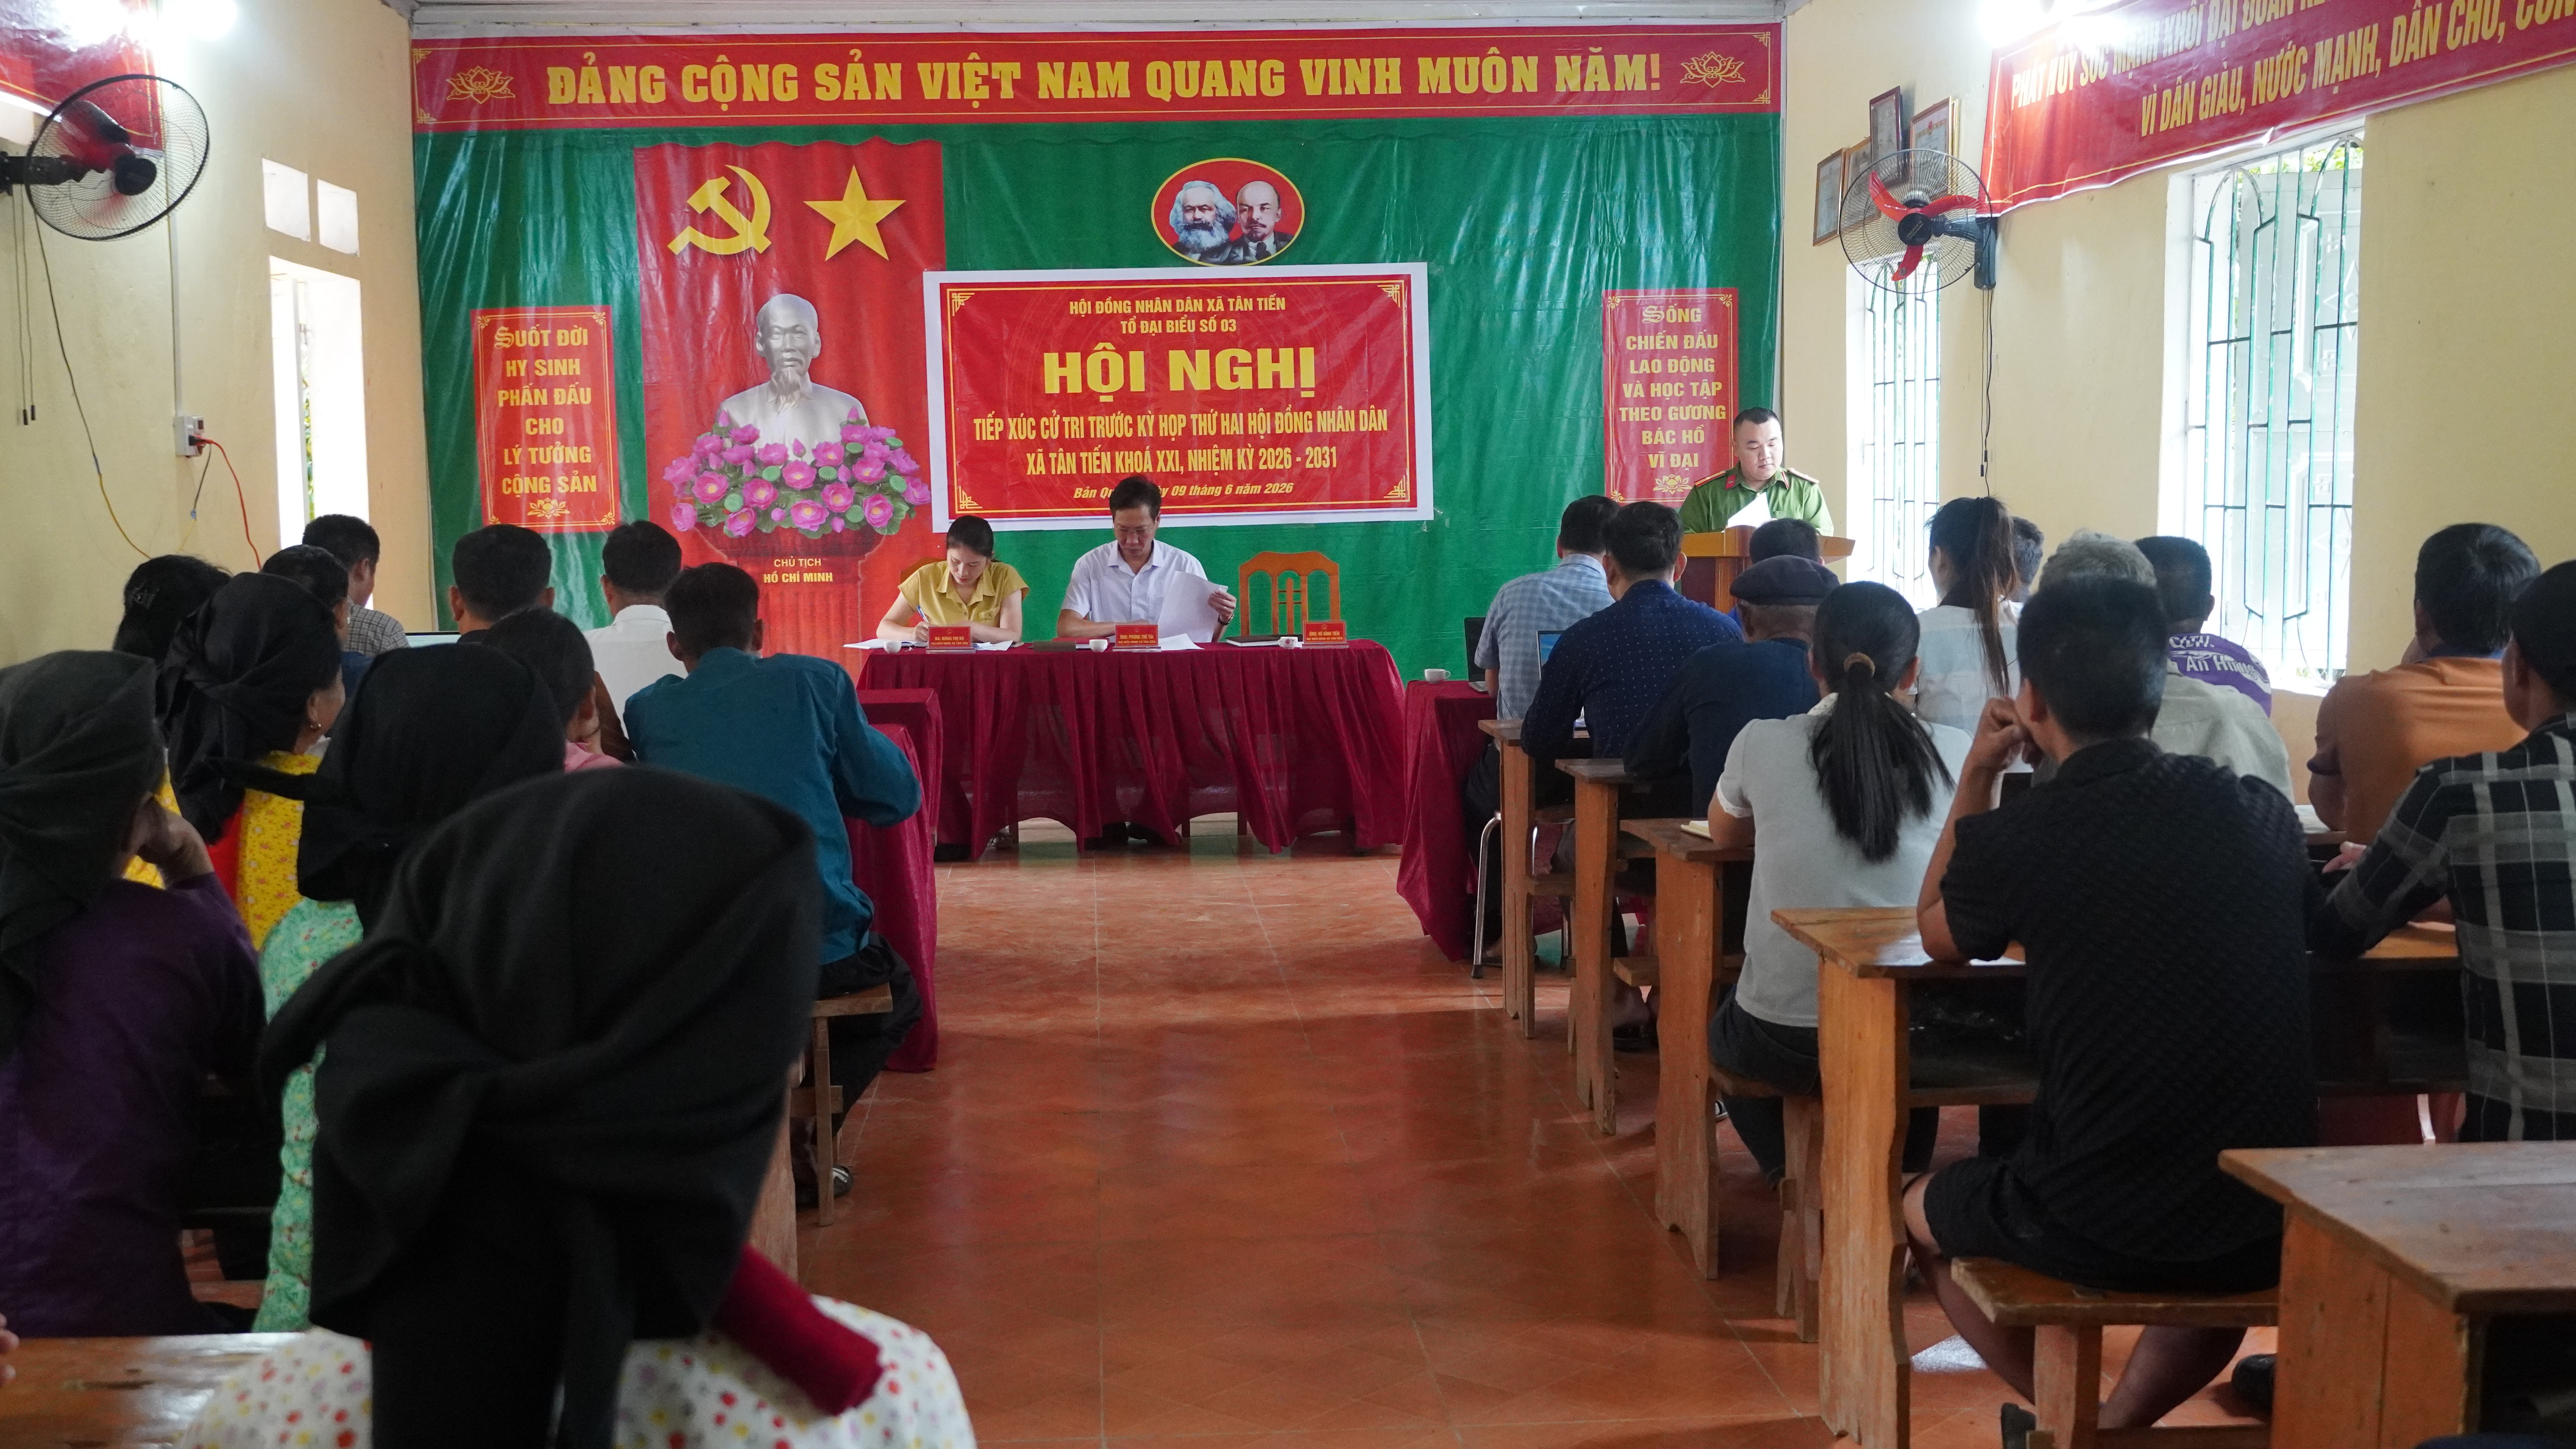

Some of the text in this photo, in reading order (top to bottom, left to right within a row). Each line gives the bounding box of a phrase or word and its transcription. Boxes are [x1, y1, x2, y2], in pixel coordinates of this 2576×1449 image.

[2045, 50, 2078, 97] HUY
[2207, 0, 2238, 49] ĐẠI
[547, 46, 1660, 111] ĐẢNG CỘNG SẢN VIỆT NAM QUANG VINH MUÔN NĂM!
[2142, 84, 2157, 136] VÌ
[2160, 76, 2196, 132] DÂN
[2199, 61, 2246, 121] GIÀU,
[2252, 40, 2308, 106] NƯỚC
[2312, 23, 2382, 94] MẠNH,
[2389, 1, 2442, 68] DÂN
[1070, 293, 1286, 317] HỘI ĐỒNG NHÂN DÂN XÃ TÂN TIẾN
[1642, 303, 1701, 324] SỐNG
[1121, 315, 1236, 336] TỔ ĐẠI BIỂU SỐ 03
[494, 324, 588, 349] SUỐT ĐỜI
[1626, 330, 1718, 350] CHIẾN ĐẤU
[506, 359, 580, 376] HY SINH
[1044, 343, 1315, 402] HỘI NGHỊ
[1630, 356, 1714, 376] LAO ĐỘNG
[498, 382, 591, 406] PHẤN ĐẤU
[1623, 379, 1722, 400] VÀ HỌC TẬP
[974, 404, 1387, 441] TIẾP XÚC CỬ TRI TRƯỚC KỲ HỌP THỨ HAI HỘI ĐỒNG NHÂN DÂN
[1619, 405, 1725, 421] THEO GƯƠNG
[526, 418, 564, 435] CHO
[1642, 425, 1704, 444] BÁC HỒ
[504, 441, 591, 464] LÝ TƯỞNG
[1027, 449, 1045, 475] XÃ
[1049, 448, 1076, 474] TÂN
[1080, 444, 1111, 473] TIẾN
[1115, 445, 1153, 473] KHOÁ
[1157, 450, 1183, 474] XXI,
[1188, 444, 1233, 475] NHIỆM
[1237, 443, 1255, 470] KỲ
[1259, 448, 1291, 469] 2026
[1306, 446, 1336, 468] 2031
[1649, 452, 1698, 470] VĨ ĐẠI
[502, 470, 596, 497] CỘNG SẢN
[1074, 487, 1097, 498] Bản
[1171, 485, 1187, 496] 09
[1189, 485, 1222, 496] tháng
[1225, 484, 1233, 494] 6
[1235, 484, 1261, 494] năm
[1264, 483, 1294, 493] 2026
[774, 556, 821, 568] CHỦ TỊCH
[764, 571, 832, 582] HỒ CHÍ MINH
